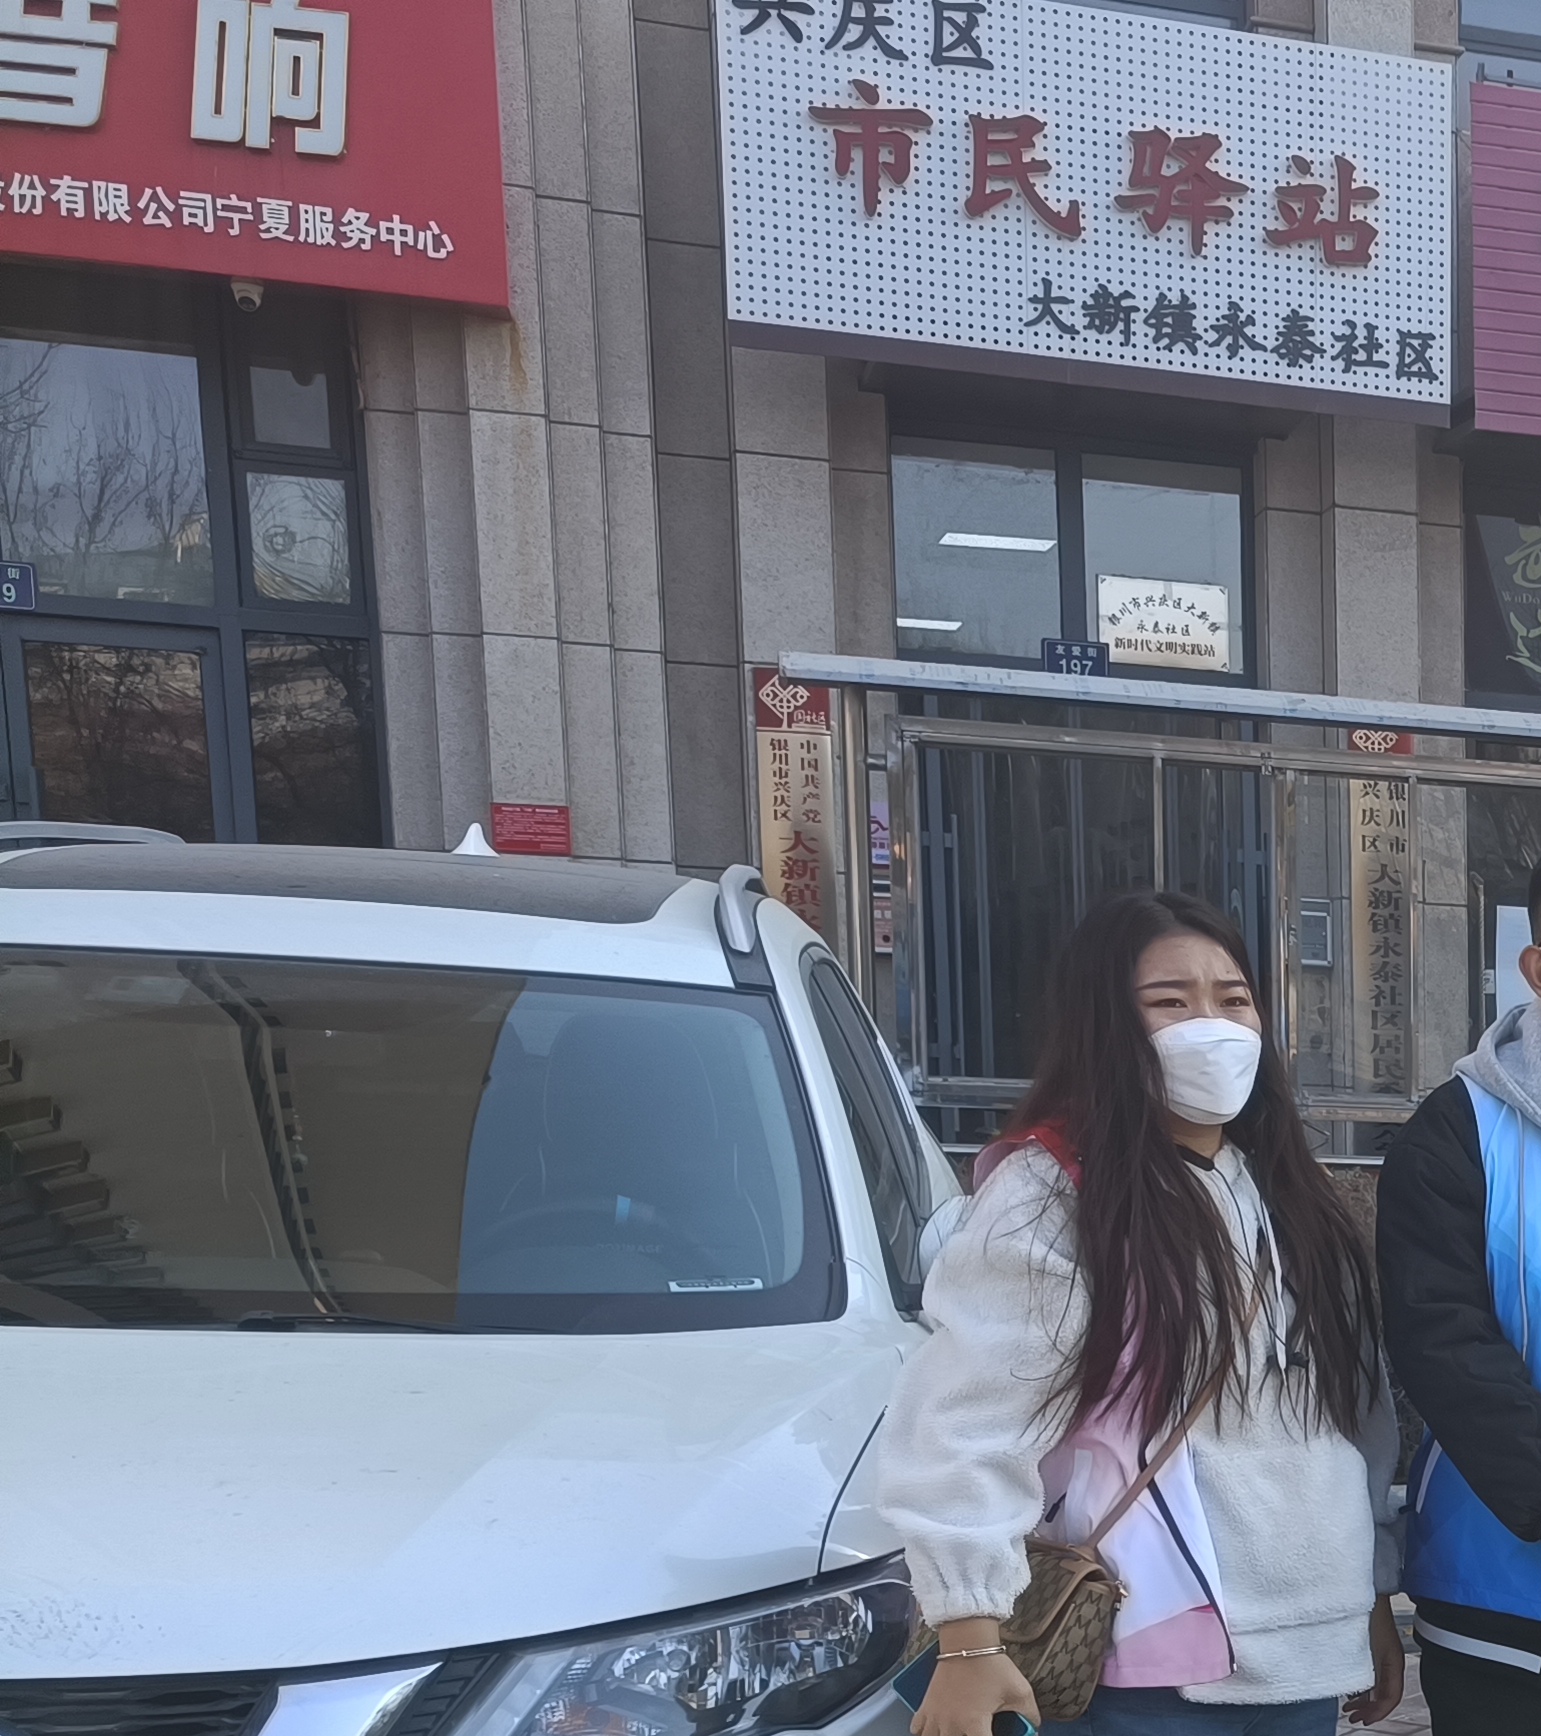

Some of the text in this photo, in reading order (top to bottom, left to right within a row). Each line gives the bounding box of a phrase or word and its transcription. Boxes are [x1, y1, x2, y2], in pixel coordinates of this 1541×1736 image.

[808, 78, 1380, 268] 市民驿站
[1022, 278, 1441, 382] 大新镇永泰社区
[1055, 644, 1098, 657] 友爱街
[1114, 636, 1216, 658] 新时代文明实践站
[1137, 619, 1191, 637] 永泰社区
[1059, 658, 1093, 676] 197
[770, 737, 792, 822] 银川市兴庆区
[800, 738, 822, 824] 中国共产党
[1359, 781, 1382, 854] 兴庆区
[1387, 781, 1408, 856] 银川市
